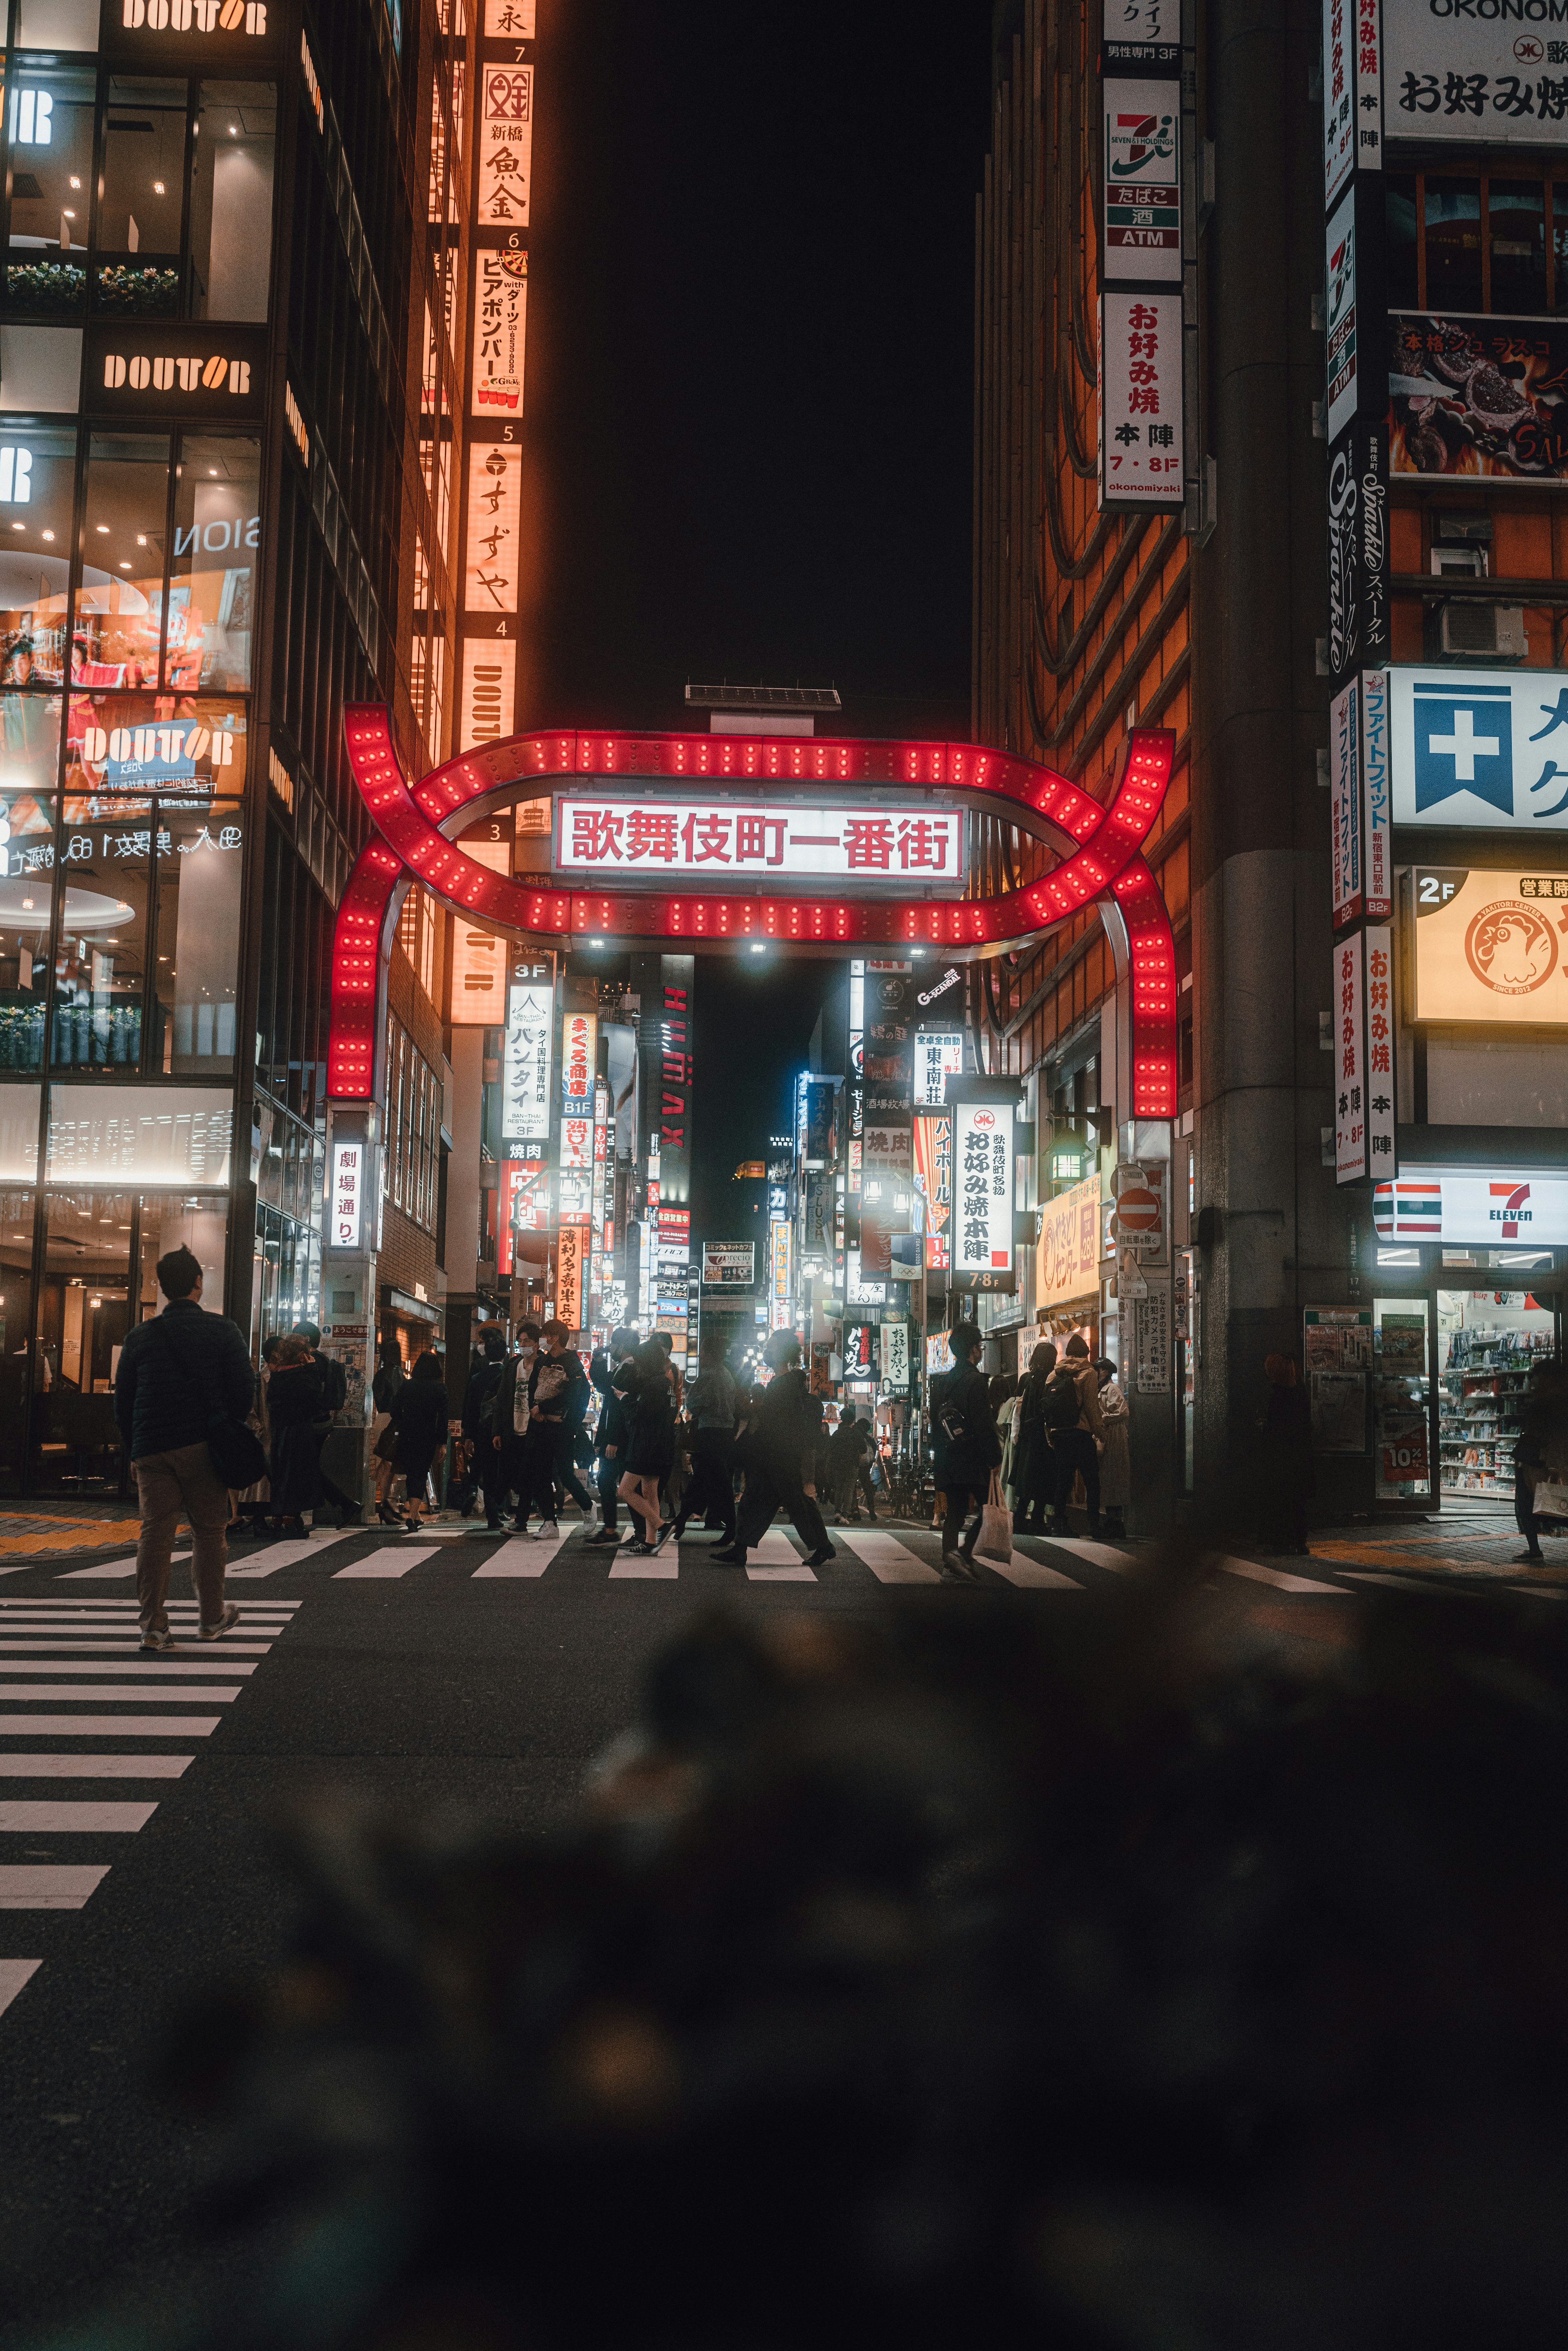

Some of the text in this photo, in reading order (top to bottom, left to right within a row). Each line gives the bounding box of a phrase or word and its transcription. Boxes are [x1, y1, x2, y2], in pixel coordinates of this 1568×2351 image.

[496, 5, 528, 33] 永
[515, 47, 525, 62] 7
[1108, 46, 1178, 59] 男性専門 3F
[490, 125, 523, 141] 新橋
[1360, 94, 1379, 148] 本陣
[483, 147, 526, 219] 魚金
[1325, 153, 1353, 200] okonomiyaki
[1118, 187, 1167, 204] たばこ
[1132, 209, 1154, 224] 酒
[509, 233, 519, 248] 6
[1122, 230, 1163, 246] ATM
[481, 257, 504, 376] ビアポンバー
[507, 289, 520, 323] ダーツ
[1332, 315, 1352, 355] たばこ
[1404, 333, 1550, 356] 本格シュラスコ
[104, 355, 251, 393] DOUTOR
[1127, 303, 1160, 414] お好み焼
[1337, 345, 1346, 371] 酒
[1334, 364, 1350, 398] ATM
[503, 426, 513, 441] 5
[1114, 423, 1174, 448] 本陣
[1370, 437, 1378, 471] 歌舞伎町
[1109, 484, 1180, 493] okonomiyaki
[1361, 473, 1385, 571] Sparkle
[476, 480, 510, 608] すずや
[1343, 519, 1358, 667] スパークル
[1365, 575, 1385, 645] スパークル
[496, 621, 507, 636] 4
[84, 726, 233, 765] DOUTOR
[1365, 694, 1387, 829] ファイトフィット
[1339, 728, 1350, 898] ファイトフィット
[490, 825, 500, 840] 3
[572, 809, 949, 870] 歌舞伎町一番街
[1372, 832, 1383, 894] 新宿東口駅前
[1419, 877, 1454, 903] 2F
[1341, 905, 1352, 924] B2F
[1368, 903, 1388, 912] B2F
[1480, 900, 1541, 918] YAKITORI CENTER
[515, 965, 546, 978] 3F
[944, 968, 956, 978] CLUB
[917, 973, 961, 1005] G-SCANDAL
[1492, 984, 1531, 995] SINCE 2012
[1341, 949, 1355, 1080] お好み焼
[1370, 949, 1390, 1074] お好み焼
[569, 1017, 589, 1097] まぐろ商店
[917, 1036, 960, 1045] 全卓全自動
[510, 1028, 534, 1108] バンタイ
[537, 1030, 546, 1103] タイ国料理専門店
[926, 1047, 942, 1104] 東南荘
[564, 1102, 590, 1113] B1F
[866, 1099, 910, 1110] 酒場牧場
[1339, 1085, 1361, 1120] 本陣
[517, 1126, 534, 1135] 3F
[1372, 1096, 1392, 1155] 本陣
[510, 1143, 541, 1158] 焼肉
[934, 1119, 951, 1203] ハイボール
[1337, 1156, 1364, 1172] okonomiyaki
[338, 1151, 356, 1239] 劇場通り
[964, 1131, 990, 1261] お好み焼本陣
[566, 1214, 583, 1223] 4F
[659, 1212, 688, 1223] 全店営業中
[1037, 1214, 1042, 1236] 2F
[1055, 1206, 1076, 1248] やきとり
[1119, 1235, 1157, 1246] 自転車を除く
[776, 1225, 788, 1295] まんが喫茶
[1056, 1248, 1078, 1289] センター
[1150, 1296, 1159, 1375] 防犯カメラ作動中
[891, 1328, 907, 1378] お好み焼き
